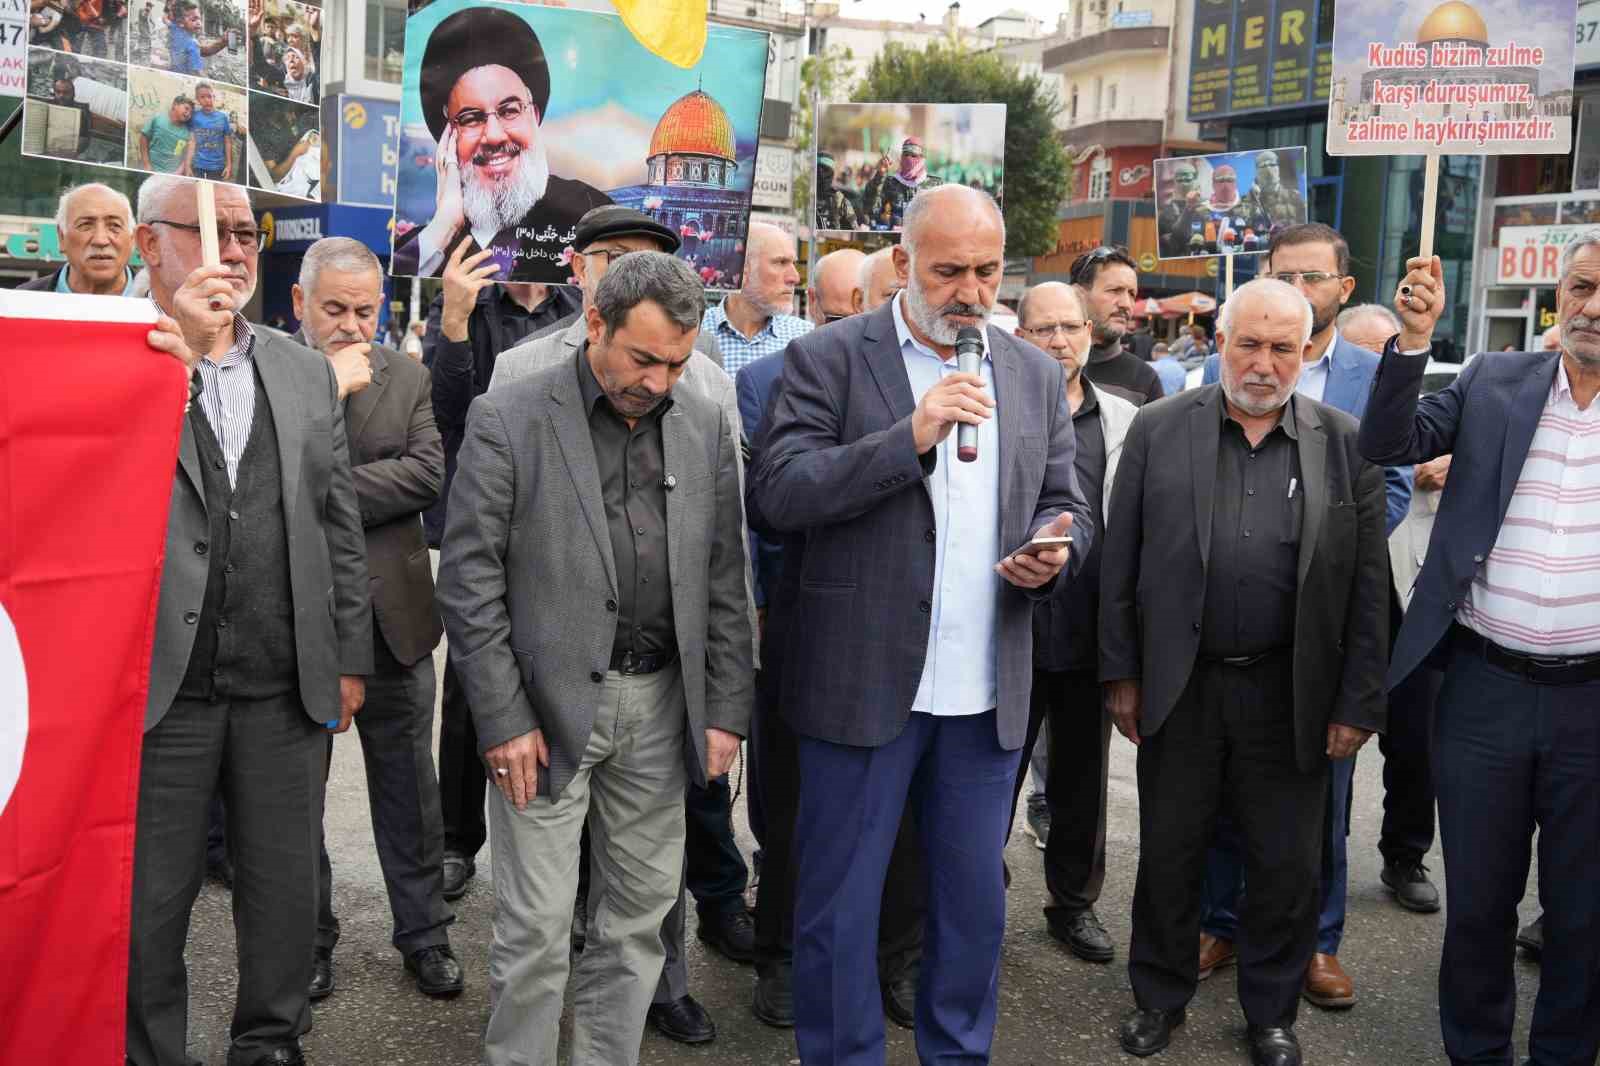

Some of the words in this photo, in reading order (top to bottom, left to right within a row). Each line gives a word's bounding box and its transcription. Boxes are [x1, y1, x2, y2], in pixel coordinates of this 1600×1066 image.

[1369, 43, 1426, 67] Kudüs
[1432, 42, 1482, 67] bizim
[1487, 41, 1543, 66] zulme
[1374, 80, 1418, 109] karşı
[1424, 80, 1535, 109] duruşumuz,
[1348, 118, 1408, 141] zalime
[1414, 117, 1555, 145] haykırışımızdır.
[1502, 237, 1559, 278] BÖR
